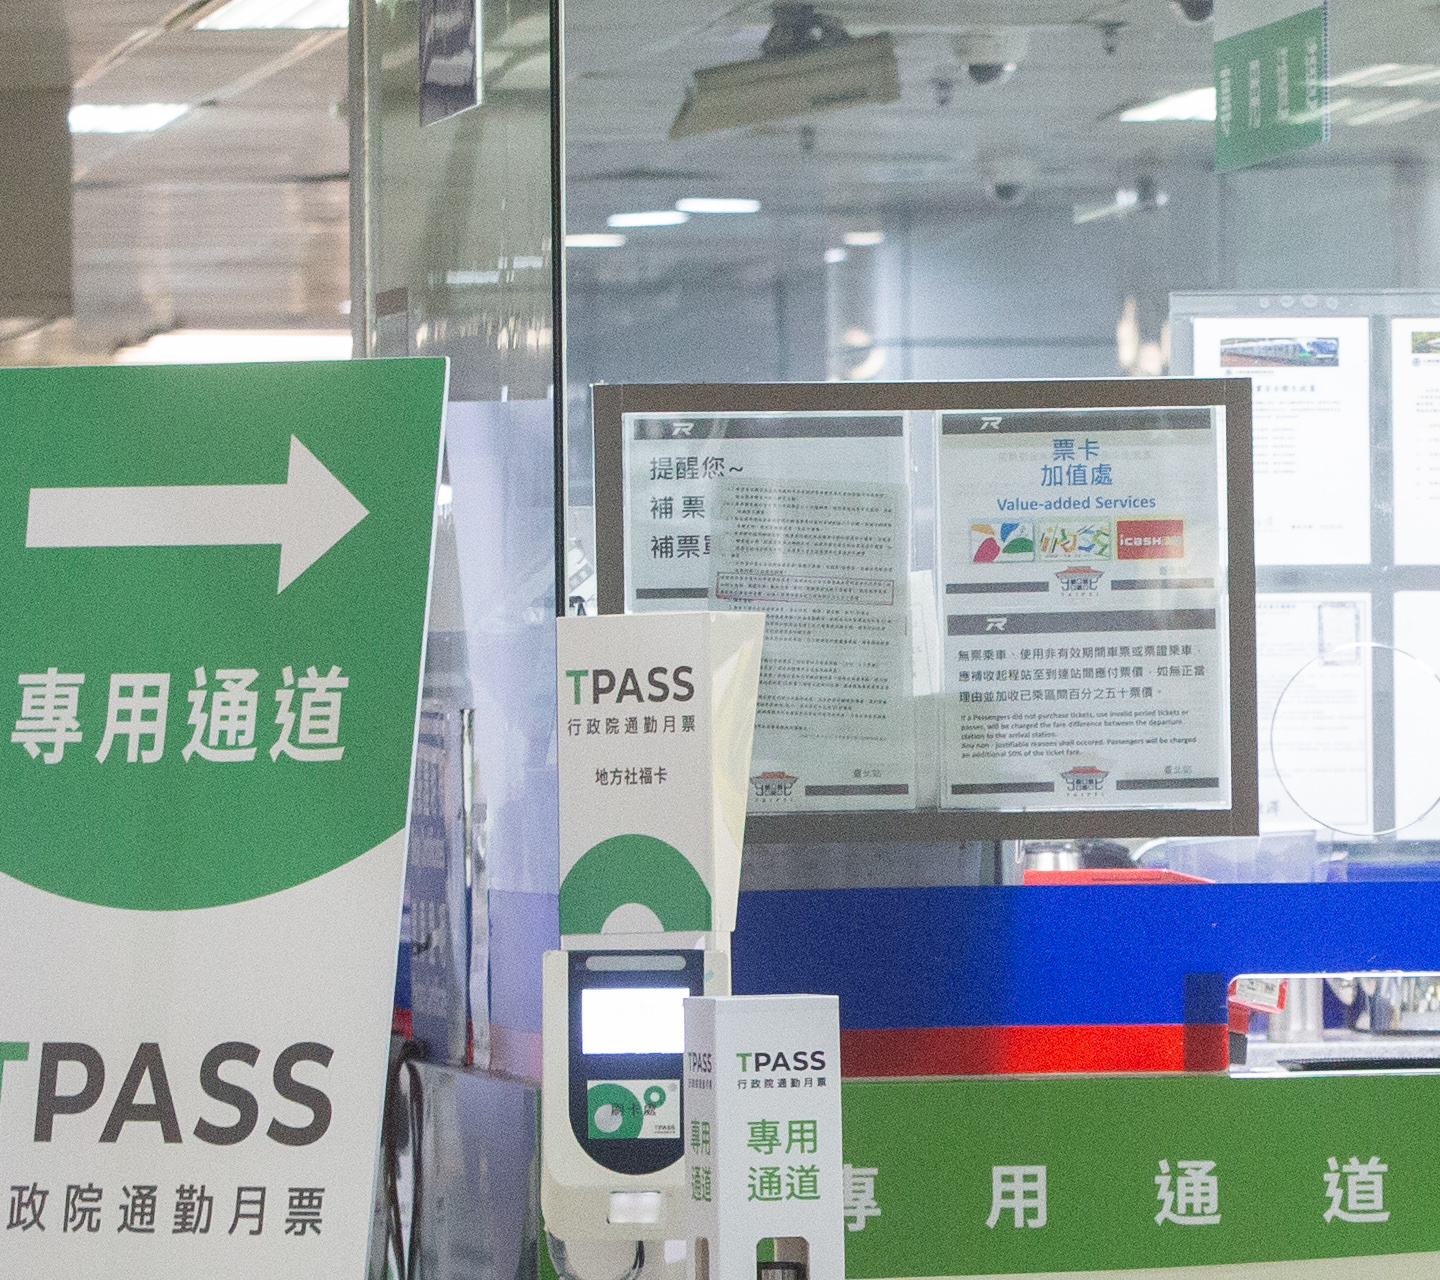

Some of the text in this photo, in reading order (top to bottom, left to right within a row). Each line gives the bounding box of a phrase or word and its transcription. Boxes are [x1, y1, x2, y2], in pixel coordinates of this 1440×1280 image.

[1053, 438, 1100, 460] 票卡
[1041, 463, 1113, 487] 加值處
[997, 495, 1156, 511] Value-added Services
[565, 666, 696, 706] TPASS
[10, 665, 350, 765] 專用通道
[567, 714, 696, 736] 行政院通勤月票
[594, 767, 668, 787] 地方社福卡
[687, 1051, 712, 1073] TPASS
[736, 1051, 826, 1072] TPASS
[737, 1077, 827, 1090] 行政院通勤月票
[746, 1118, 818, 1155] 專用
[747, 1164, 821, 1202] 通道
[843, 1156, 1391, 1231] 專用通道
